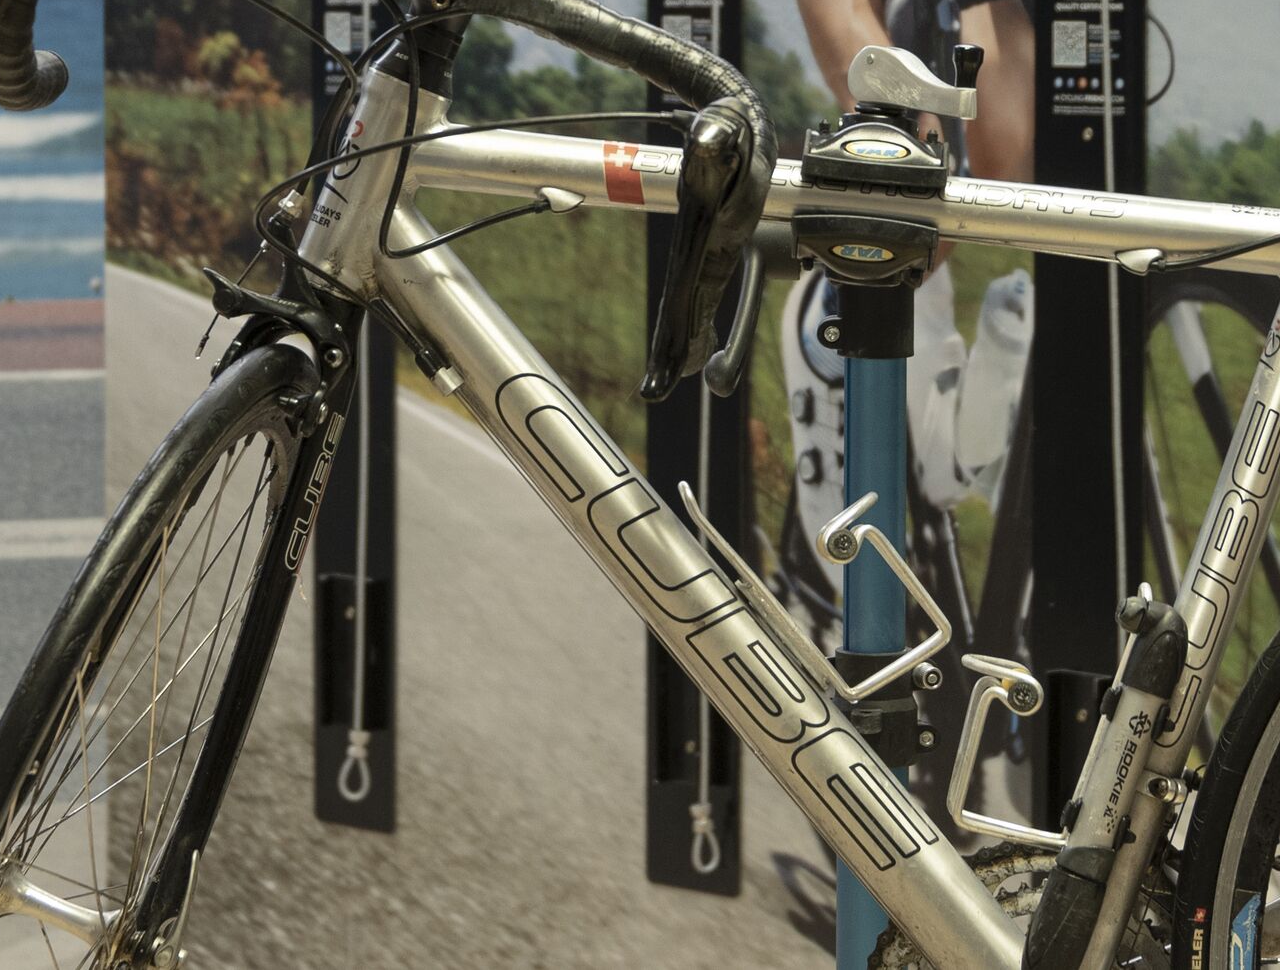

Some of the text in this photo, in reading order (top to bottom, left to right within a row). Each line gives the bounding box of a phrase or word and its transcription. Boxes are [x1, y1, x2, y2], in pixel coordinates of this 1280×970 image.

[284, 411, 345, 571] CUBE
[495, 373, 938, 871] CUBE
[1103, 740, 1138, 818] ROOKIE XL
